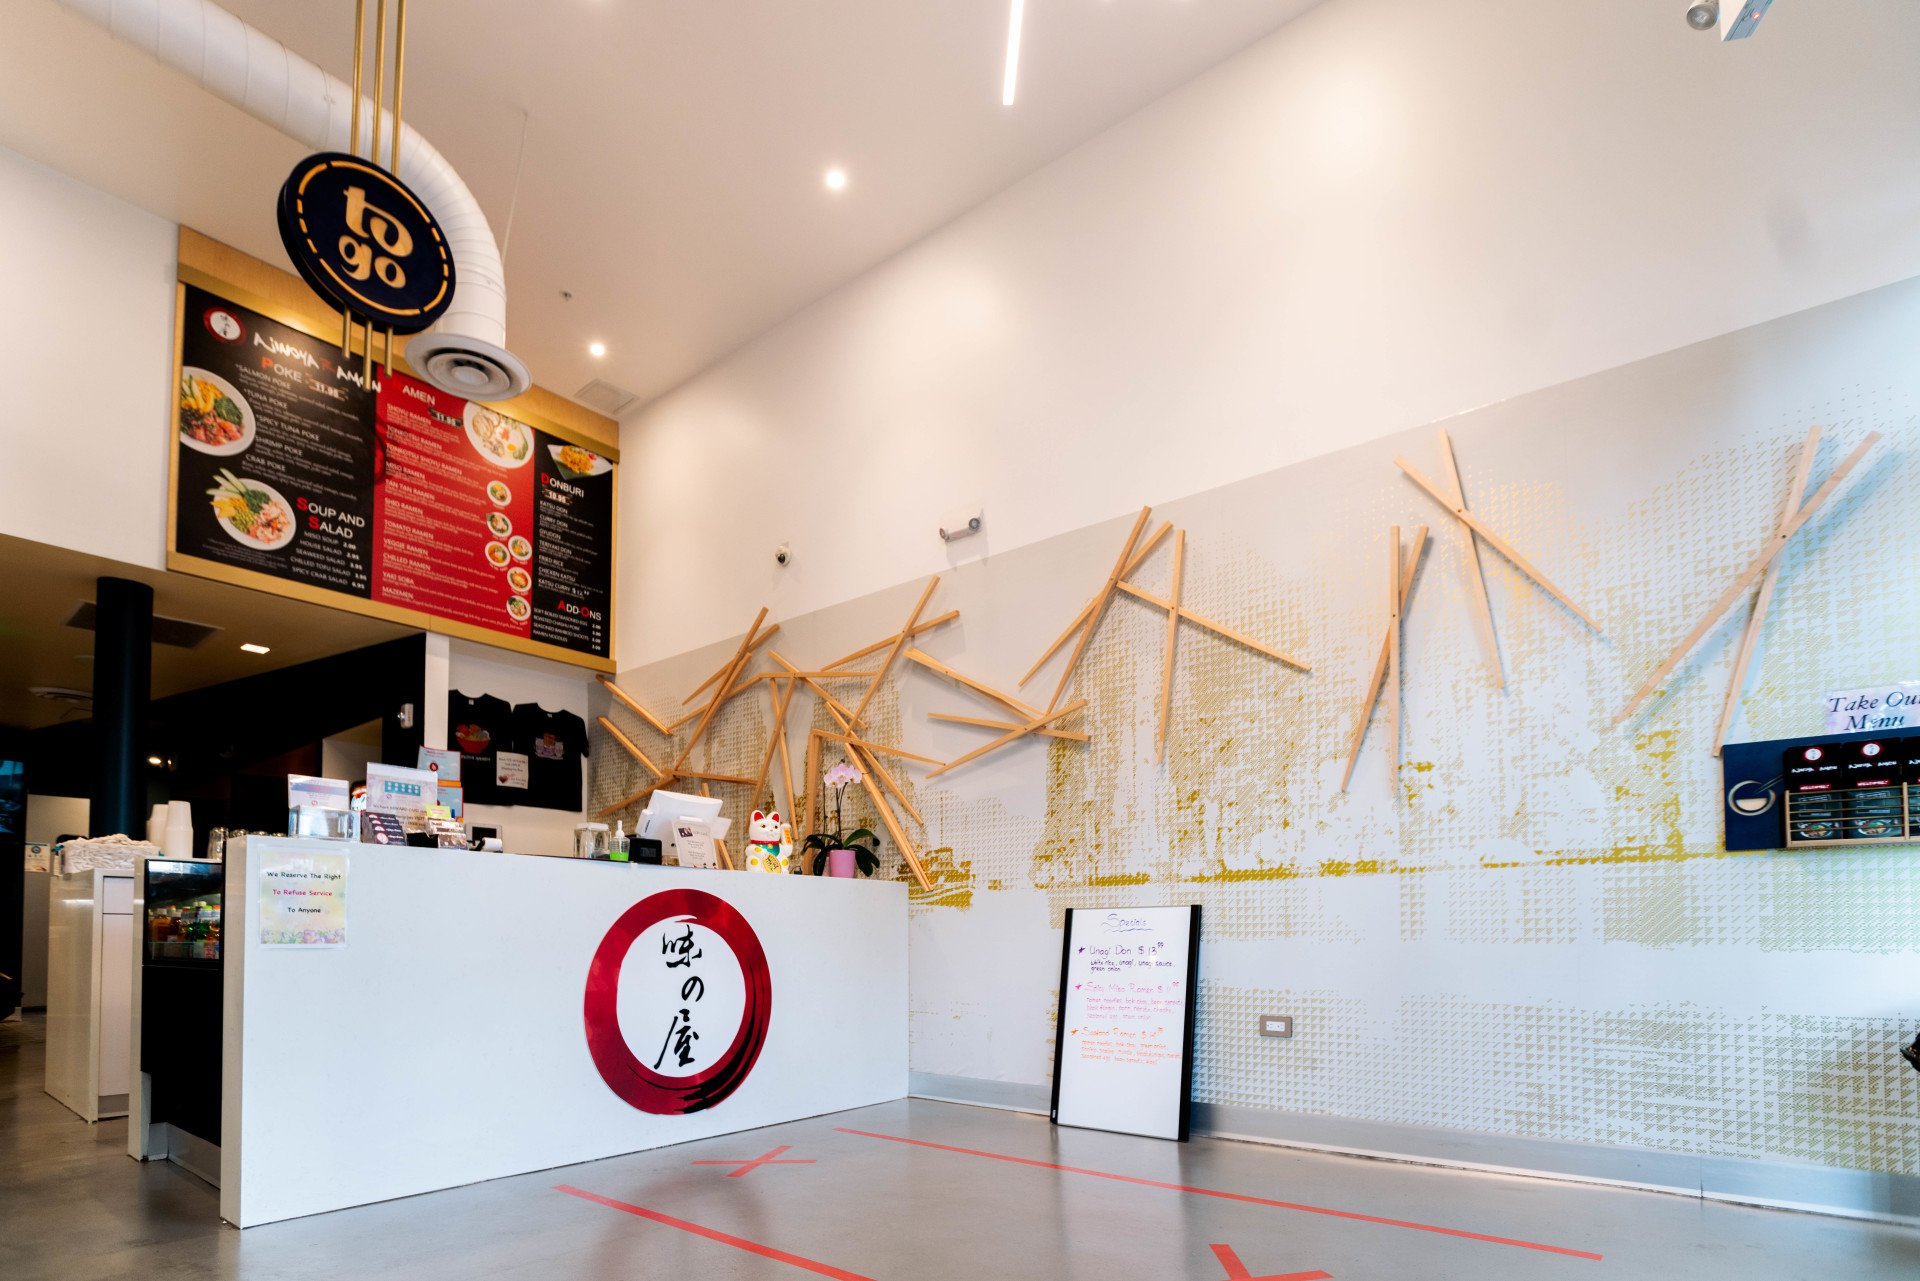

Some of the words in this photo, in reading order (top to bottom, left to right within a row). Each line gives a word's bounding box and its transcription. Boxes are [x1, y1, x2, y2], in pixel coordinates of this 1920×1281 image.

[343, 185, 413, 258] to
[338, 234, 406, 289] go
[261, 356, 303, 383] POKE
[272, 379, 292, 390] POKE
[269, 397, 288, 409] POKE
[410, 410, 432, 426] RAMEN
[280, 422, 300, 435] TUNA
[302, 429, 320, 441] POKE
[256, 435, 282, 450] SHRIMP
[284, 444, 303, 457] POKE
[420, 435, 442, 450] RAMEN
[245, 454, 266, 466] CRAB
[267, 460, 286, 472] POKE
[441, 461, 462, 475] RAMEN
[403, 466, 425, 480] RAMEN
[413, 487, 435, 501] RAMEN
[541, 472, 584, 498] DONBURI
[296, 497, 337, 519] SOUP
[338, 512, 365, 528] AND
[401, 502, 423, 516] RAMEN
[309, 516, 353, 539] SALAD
[384, 519, 411, 533] TOMATO
[412, 527, 434, 540] RAMEN
[300, 540, 321, 551] HOUSE
[322, 545, 342, 555] SALAD
[322, 535, 339, 545] SOUP
[384, 538, 405, 549] VEGGIE
[407, 544, 429, 556] RAMEN
[296, 548, 324, 561] SEAWEED
[325, 555, 345, 566] SALAD
[383, 553, 408, 565] CHILLED
[409, 559, 431, 571] RAMEN
[290, 556, 316, 568] CHILLED
[316, 562, 331, 572] TOFU
[332, 566, 351, 577] SALAD
[292, 566, 310, 576] SPICY
[311, 570, 327, 580] CRAB
[328, 574, 348, 585] SALAD
[383, 571, 398, 581] YAKI
[382, 586, 414, 599] MAZEMEN
[557, 600, 602, 621] ADD-ONS
[1829, 694, 1879, 712] Take
[1886, 692, 1920, 707] Ou
[1843, 714, 1904, 730] Menu
[1101, 913, 1147, 928] Specials
[1090, 945, 1111, 959] Unagi
[1115, 945, 1131, 955] Don
[654, 924, 704, 1070] 味の屋
